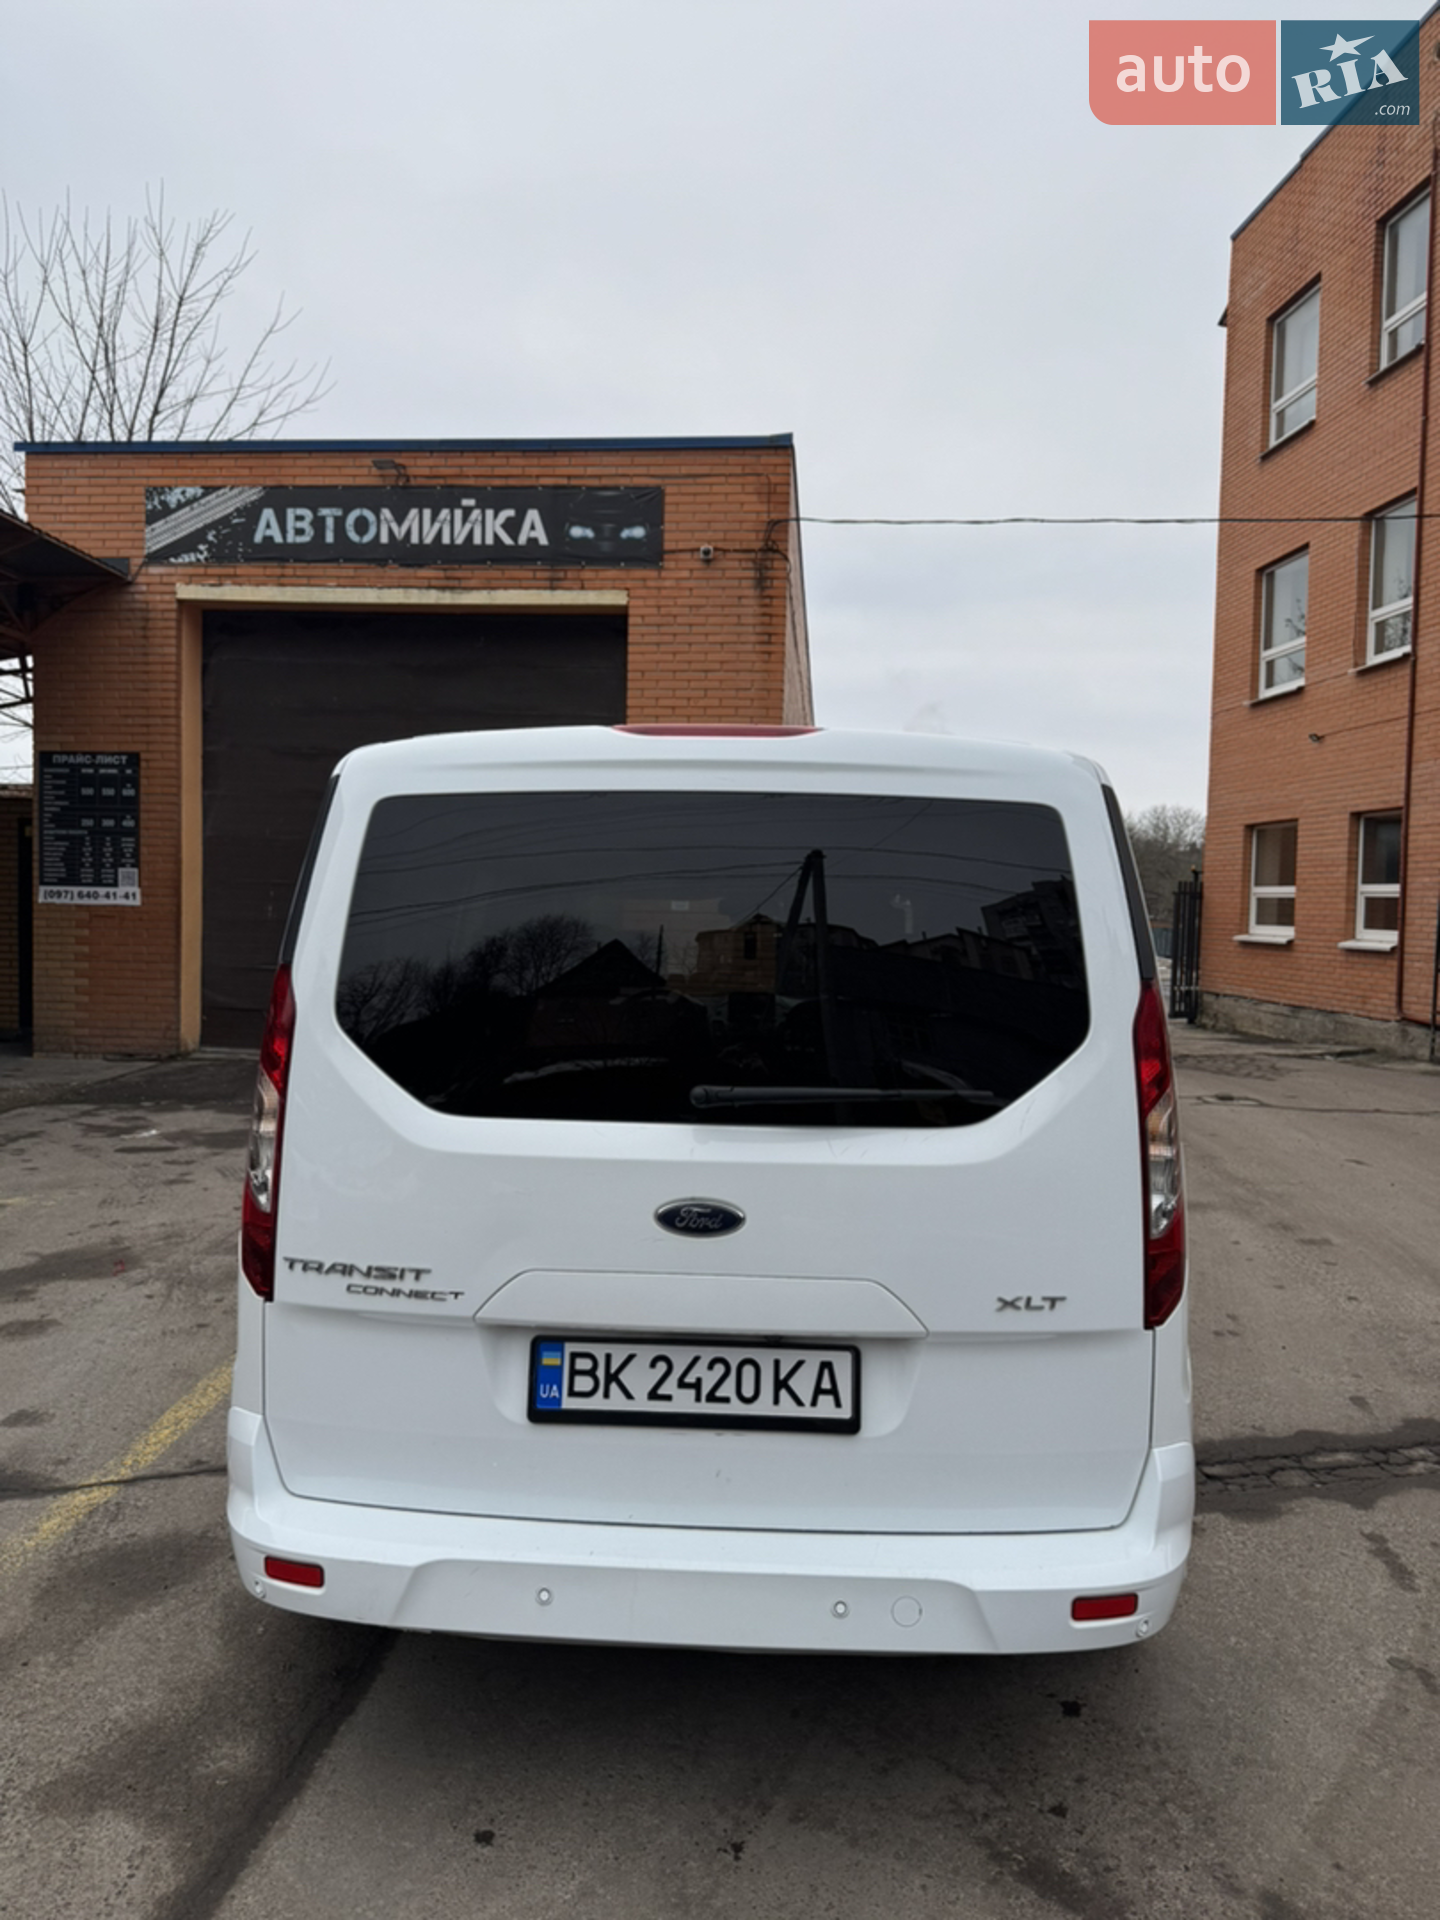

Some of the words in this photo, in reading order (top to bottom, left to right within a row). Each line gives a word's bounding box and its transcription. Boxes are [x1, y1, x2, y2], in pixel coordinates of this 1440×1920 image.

[253, 498, 549, 546] АВТОМИЙКА
[52, 753, 128, 765] ПРАЙС-ЛИСТ
[43, 889, 74, 900] (097)
[77, 890, 136, 900] 640-41-41
[675, 1206, 723, 1229] Ford
[283, 1256, 432, 1282] TRANSIT
[346, 1283, 465, 1302] CONNECT
[995, 1296, 1067, 1312] XLT
[567, 1351, 637, 1400] BK
[647, 1354, 761, 1405] 2420
[772, 1358, 842, 1408] KA
[540, 1385, 560, 1398] UA
